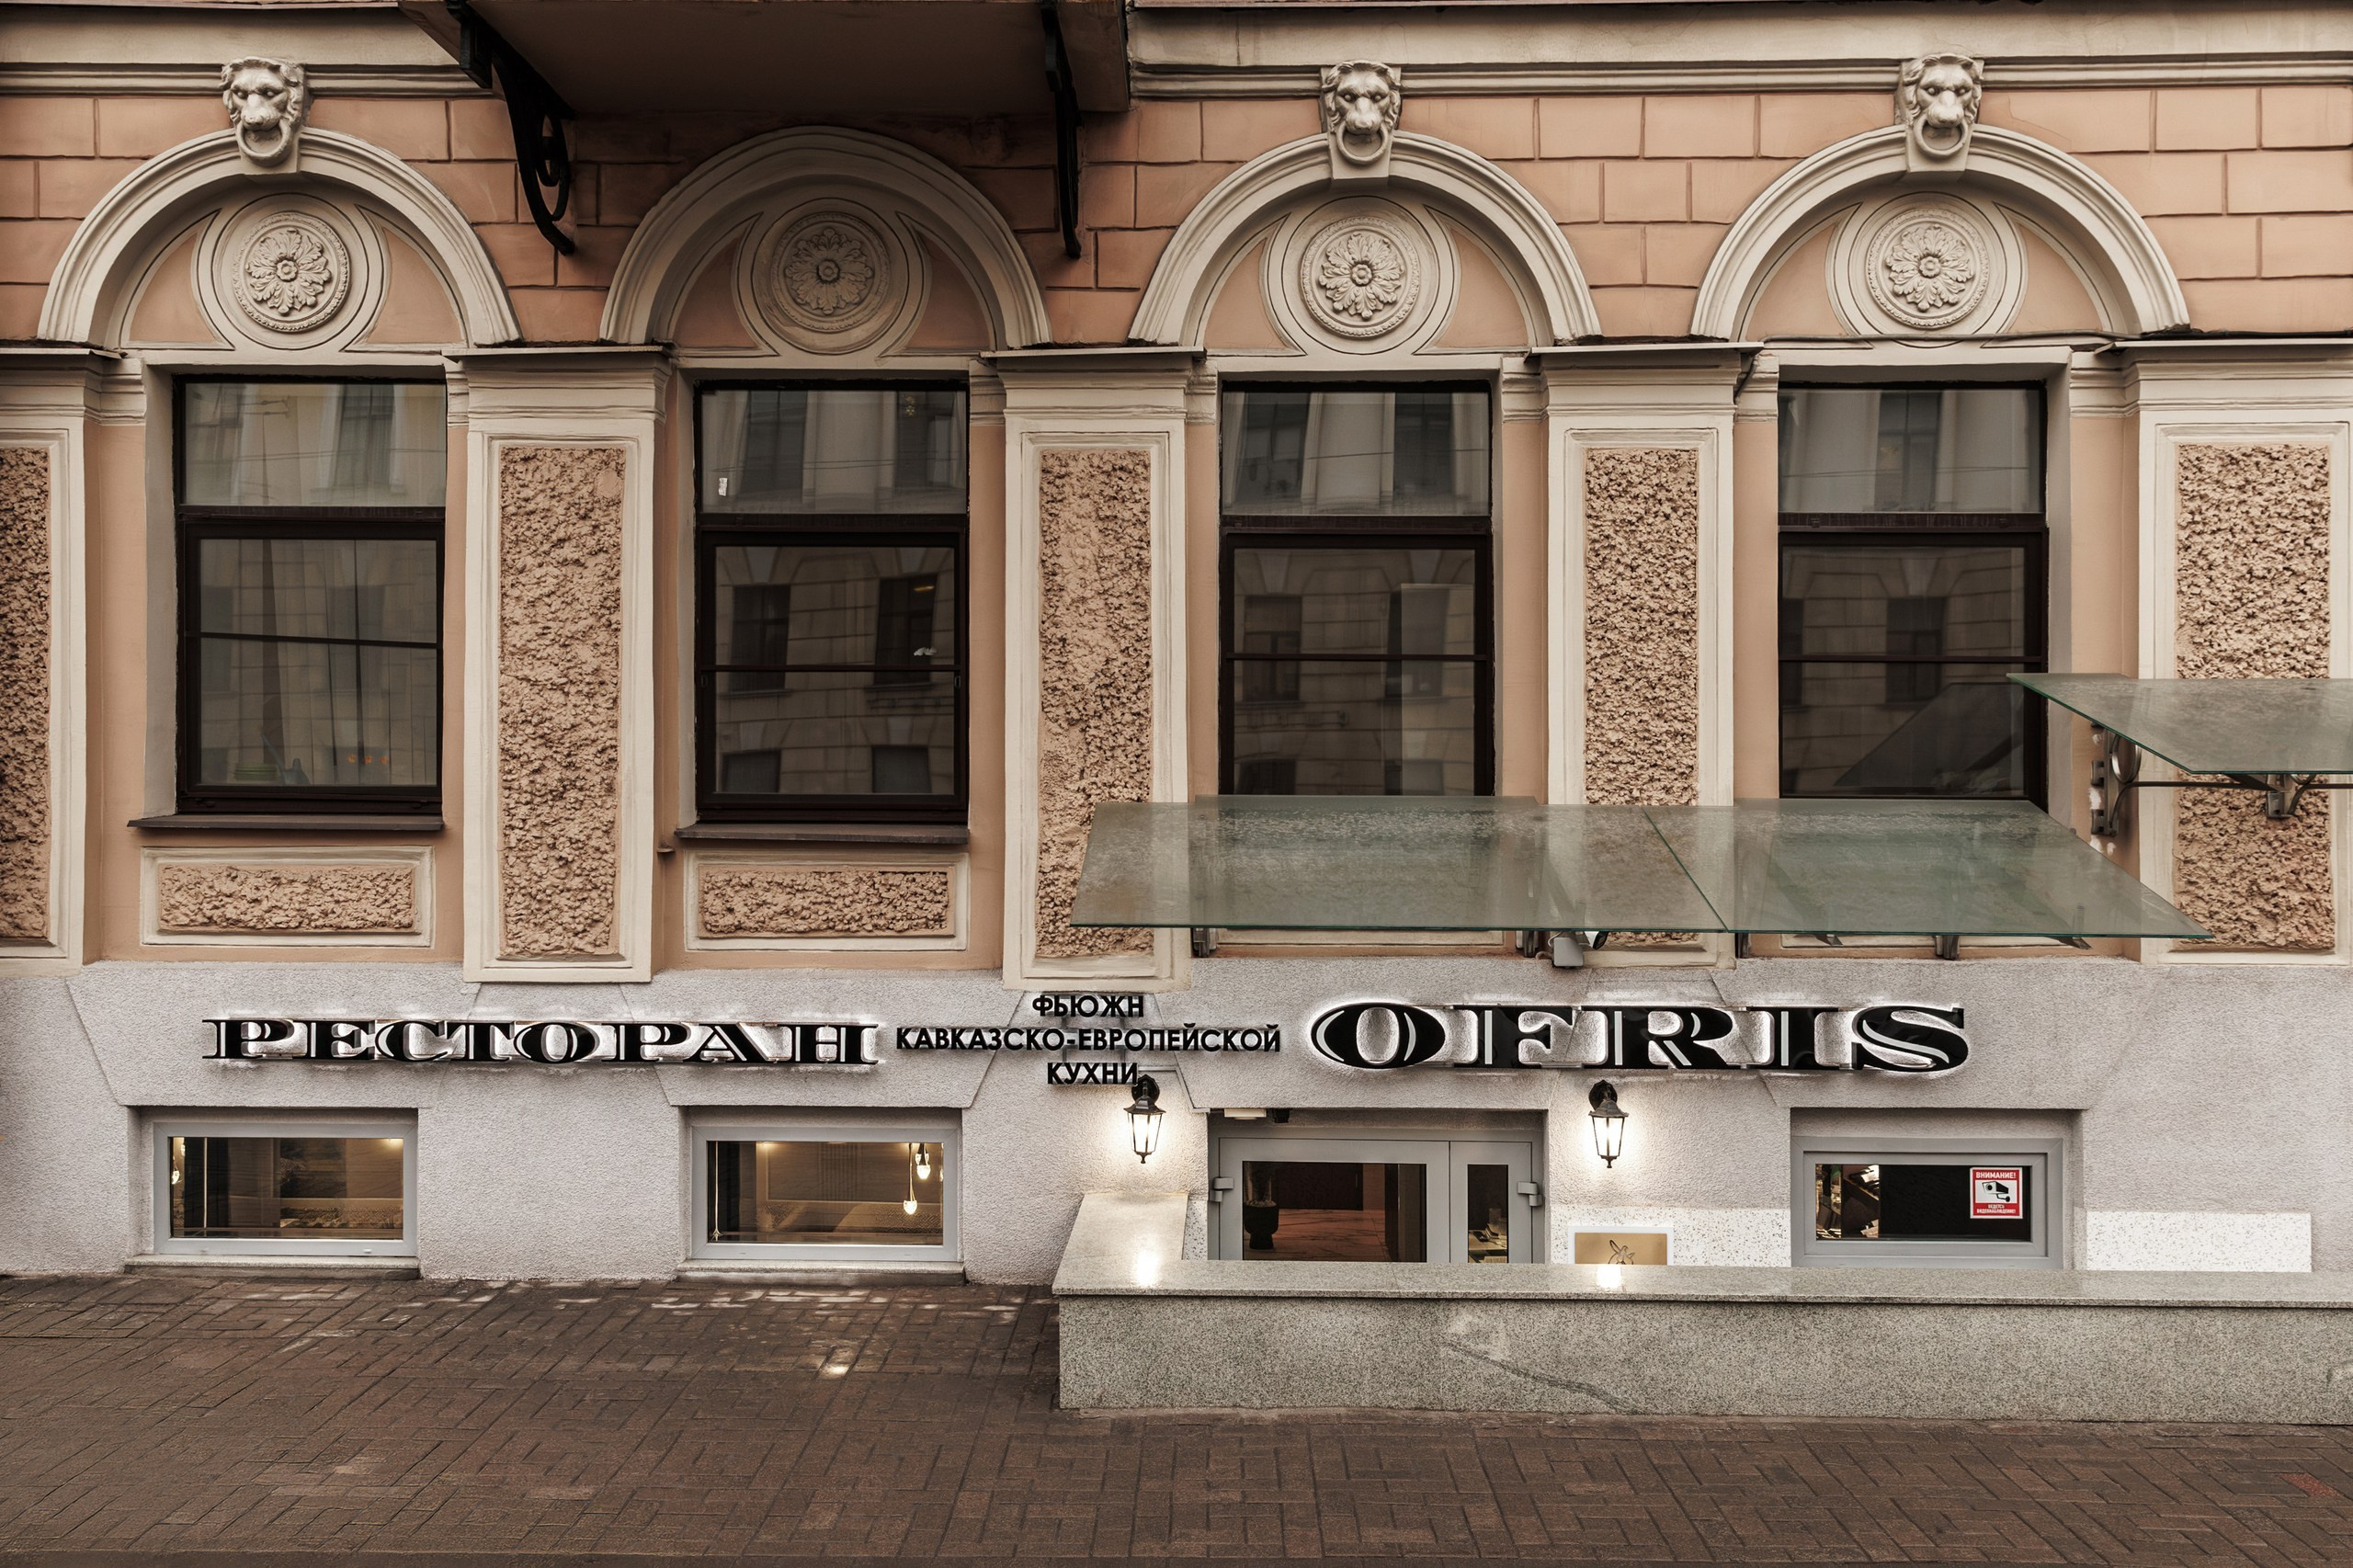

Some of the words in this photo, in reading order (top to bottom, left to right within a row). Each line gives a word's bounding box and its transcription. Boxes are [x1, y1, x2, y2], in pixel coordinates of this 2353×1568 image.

[1032, 994, 1144, 1017] ФЬЮЖН
[202, 1018, 880, 1065] РЕСТОРАН
[896, 1023, 1281, 1052] КАВКАЗСКО-ЕВРОПЕЙСКОЙ
[1311, 1003, 1970, 1070] OFRIS
[1048, 1062, 1138, 1085] КУХНИ
